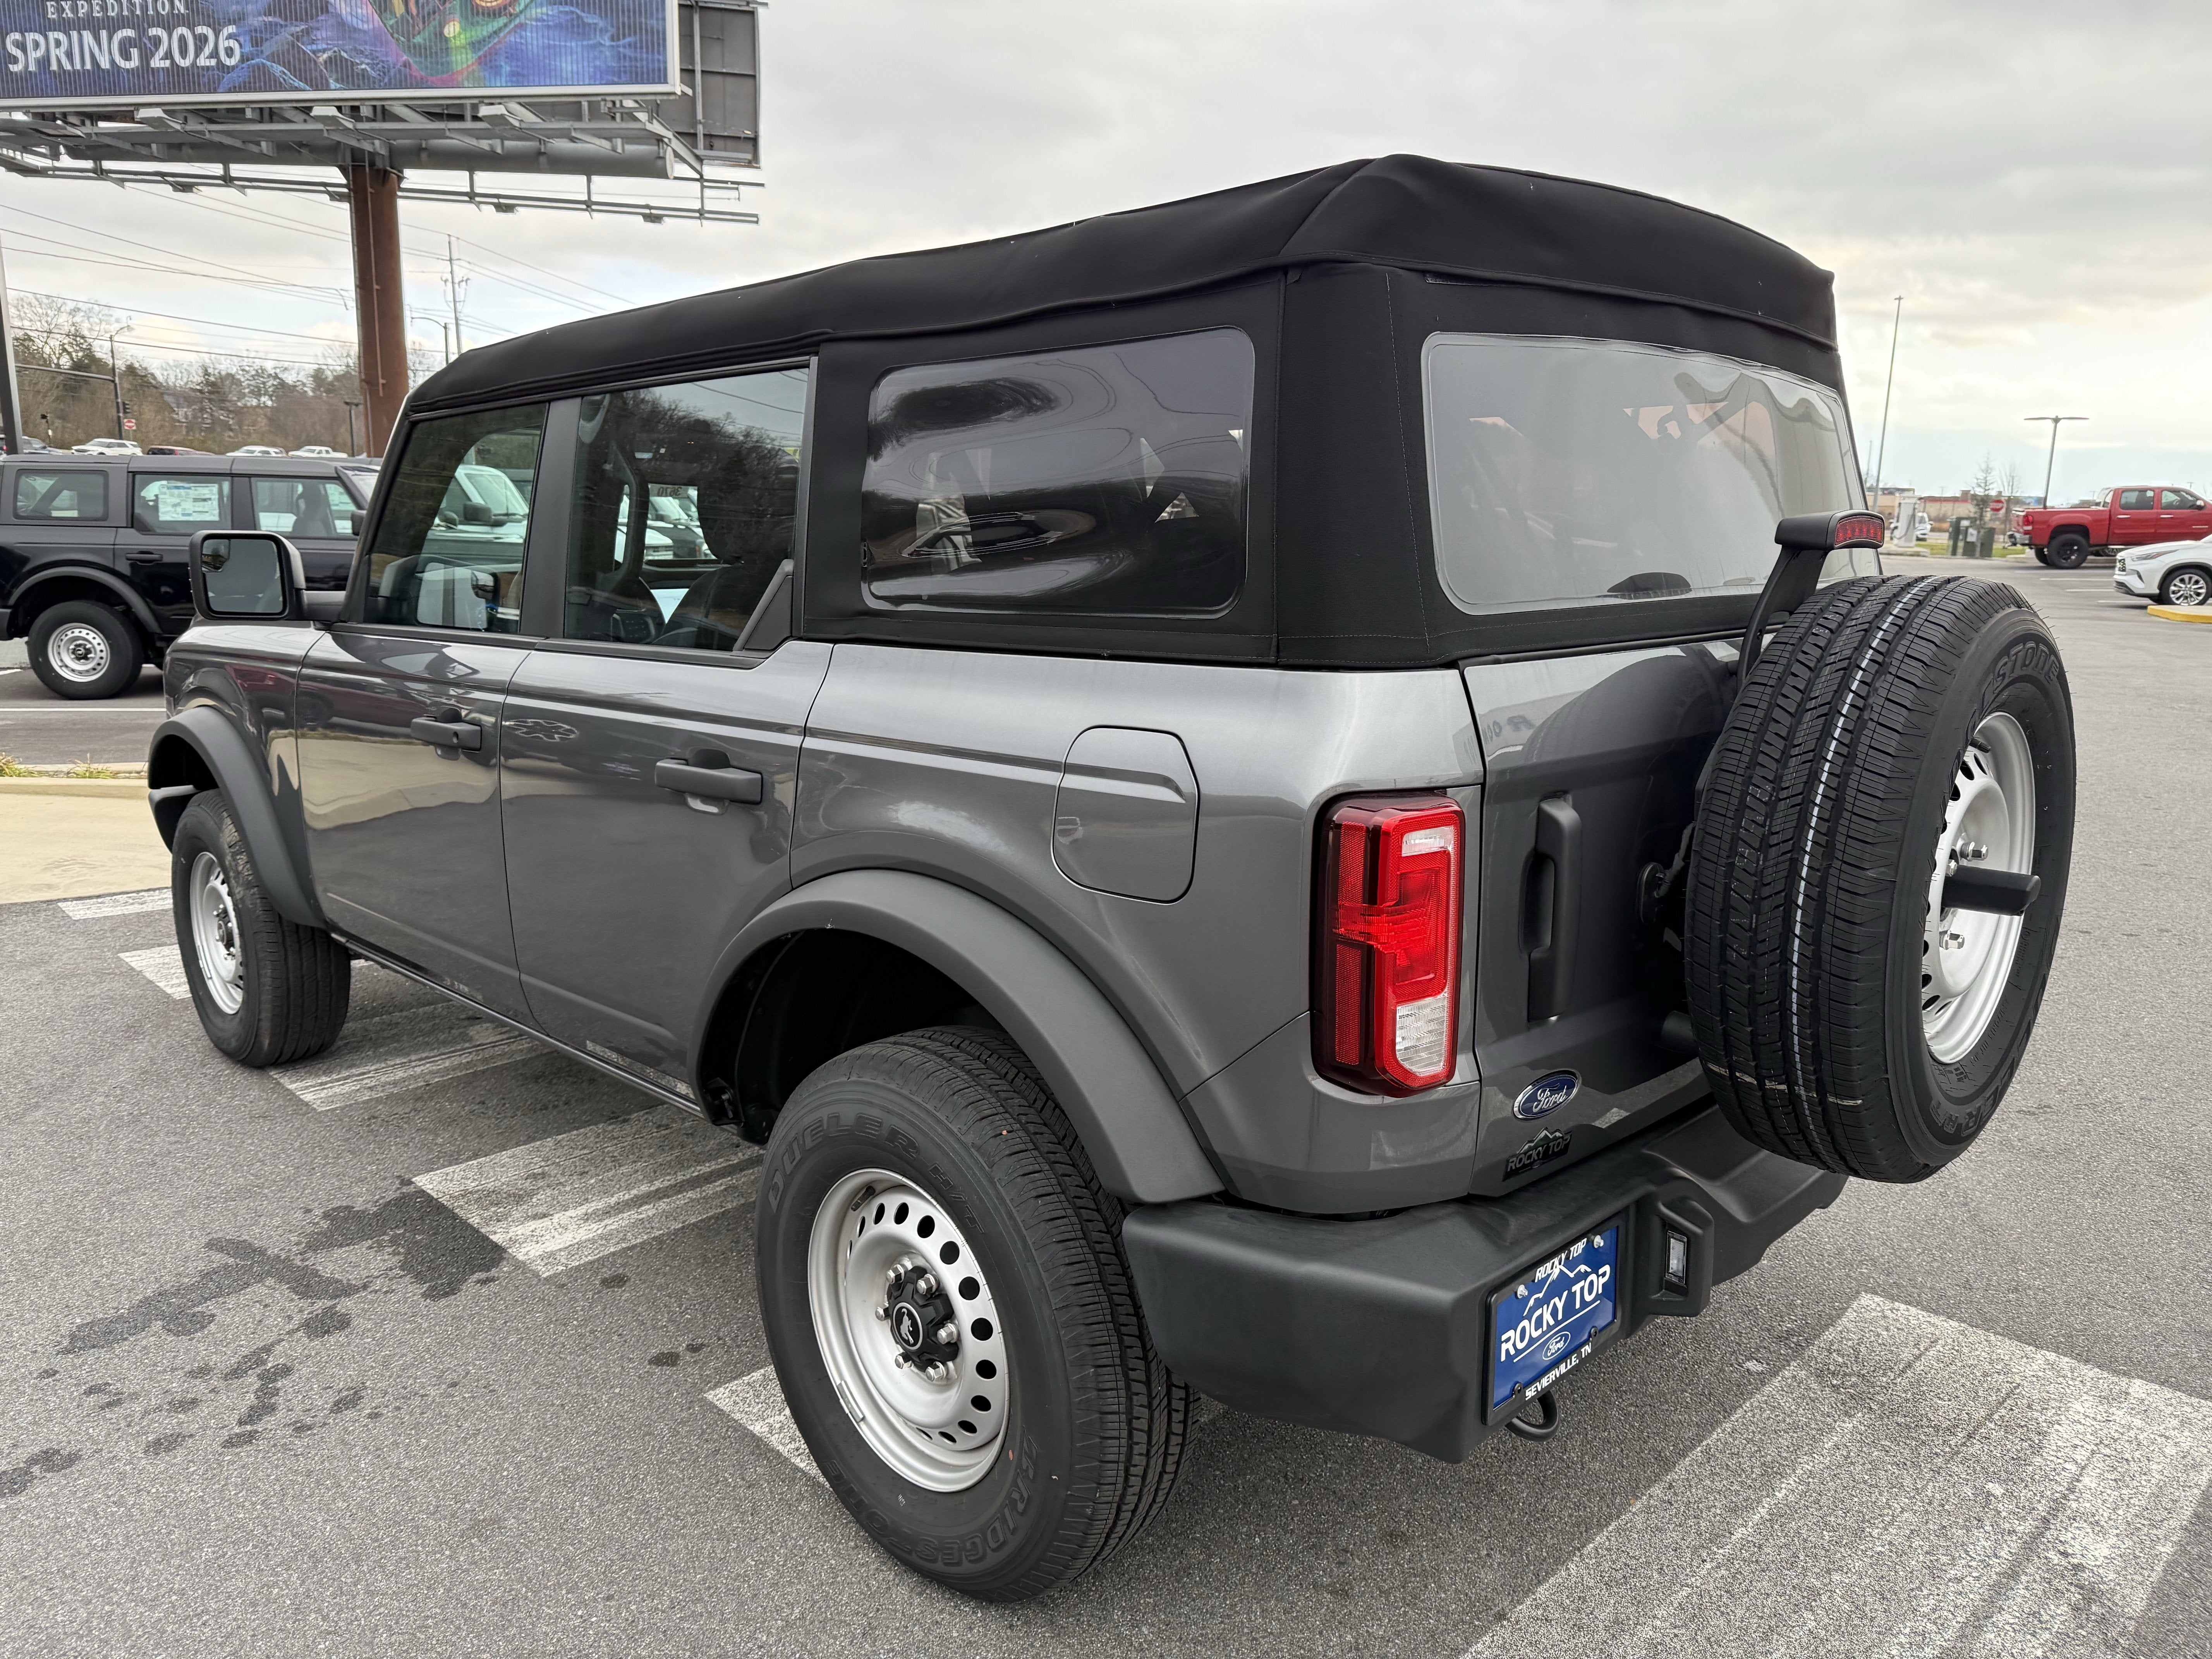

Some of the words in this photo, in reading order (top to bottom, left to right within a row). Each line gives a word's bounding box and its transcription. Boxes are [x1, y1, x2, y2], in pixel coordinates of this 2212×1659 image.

[5, 28, 140, 72] SPRING
[148, 25, 240, 68] 2026
[1532, 1083, 1568, 1113] Ford
[768, 1111, 920, 1214] DUELER
[929, 1162, 986, 1234] H/T
[1507, 1144, 1548, 1172] ROCKY
[1549, 1133, 1571, 1154] TOP
[1534, 1250, 1568, 1283] ROCKY
[1569, 1238, 1587, 1261] TOP
[1500, 1290, 1569, 1362] ROCKY
[1571, 1264, 1611, 1309] TOP
[1546, 1336, 1566, 1356] Ford
[1525, 1353, 1580, 1401] SEVIERVILLE,
[1580, 1343, 1592, 1359] TN
